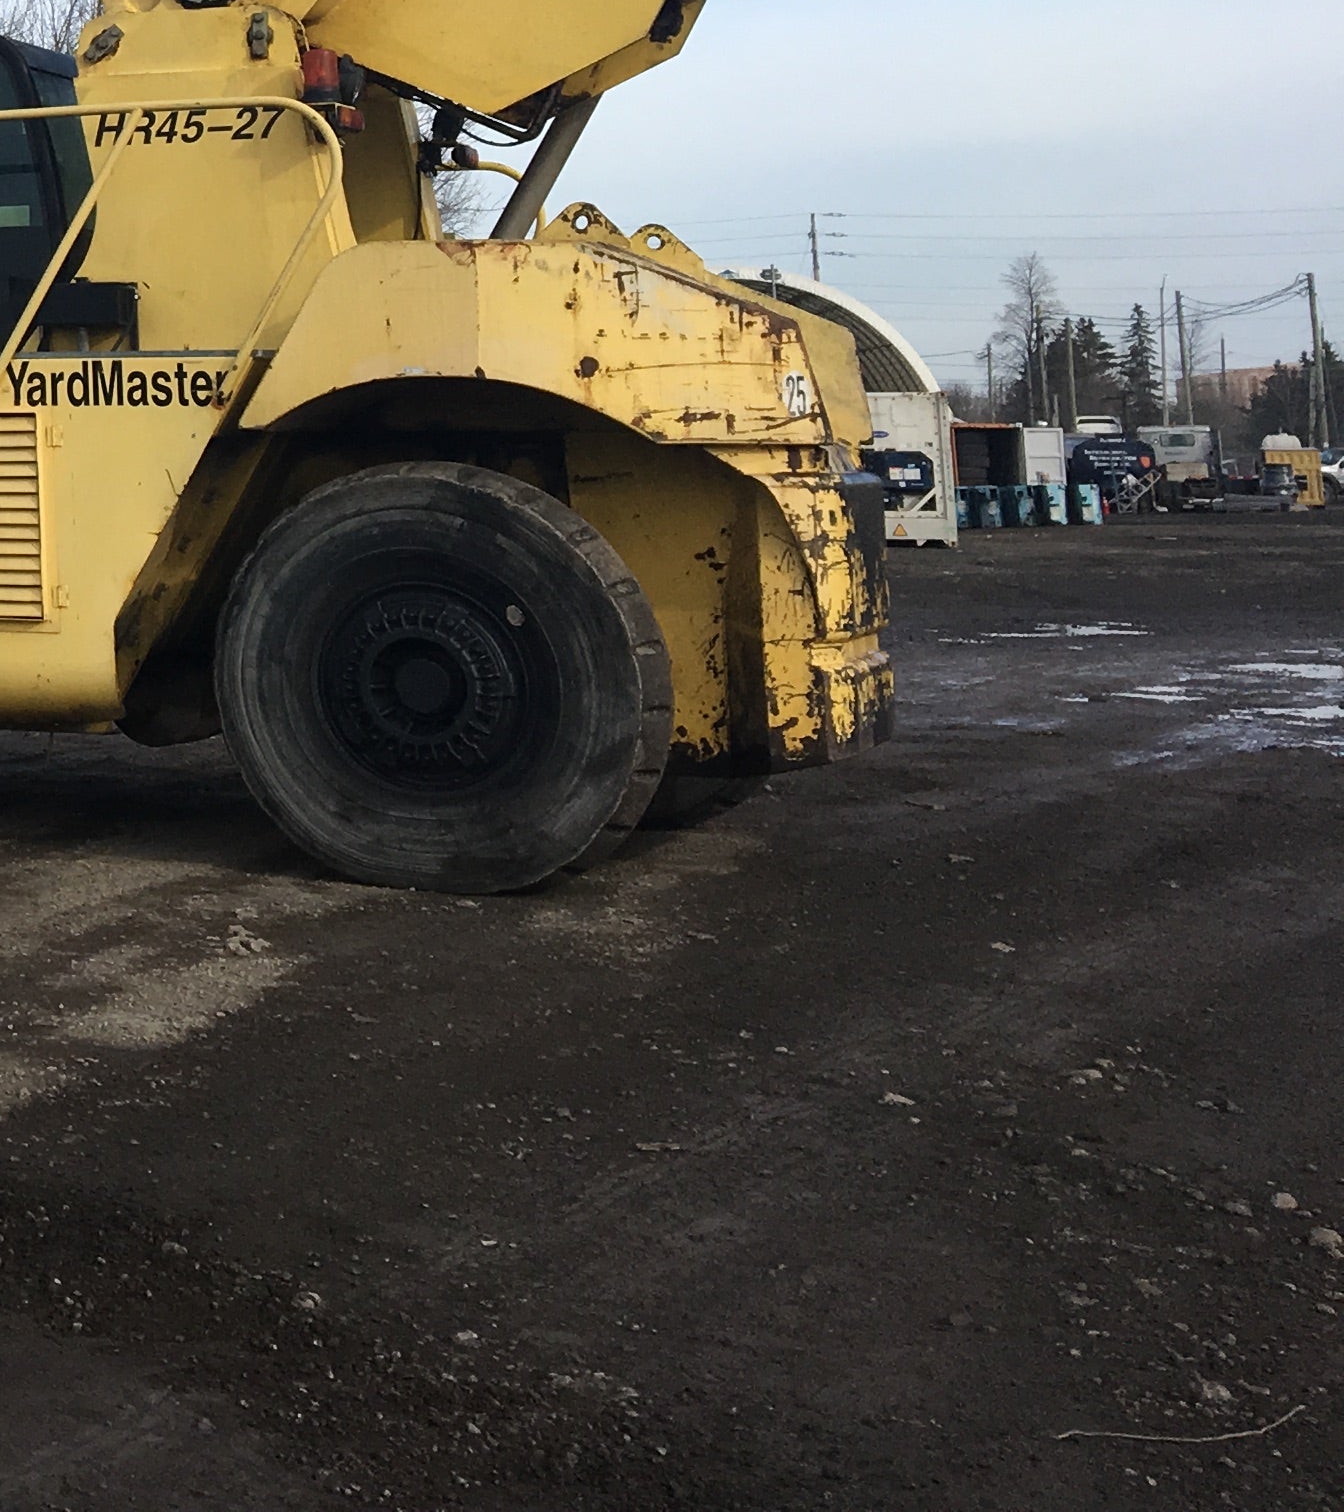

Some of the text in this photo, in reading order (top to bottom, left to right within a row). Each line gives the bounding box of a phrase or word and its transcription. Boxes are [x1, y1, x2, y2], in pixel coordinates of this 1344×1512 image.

[94, 106, 288, 148] HR45-27
[5, 360, 230, 408] YardMaster
[785, 375, 807, 417] 25
